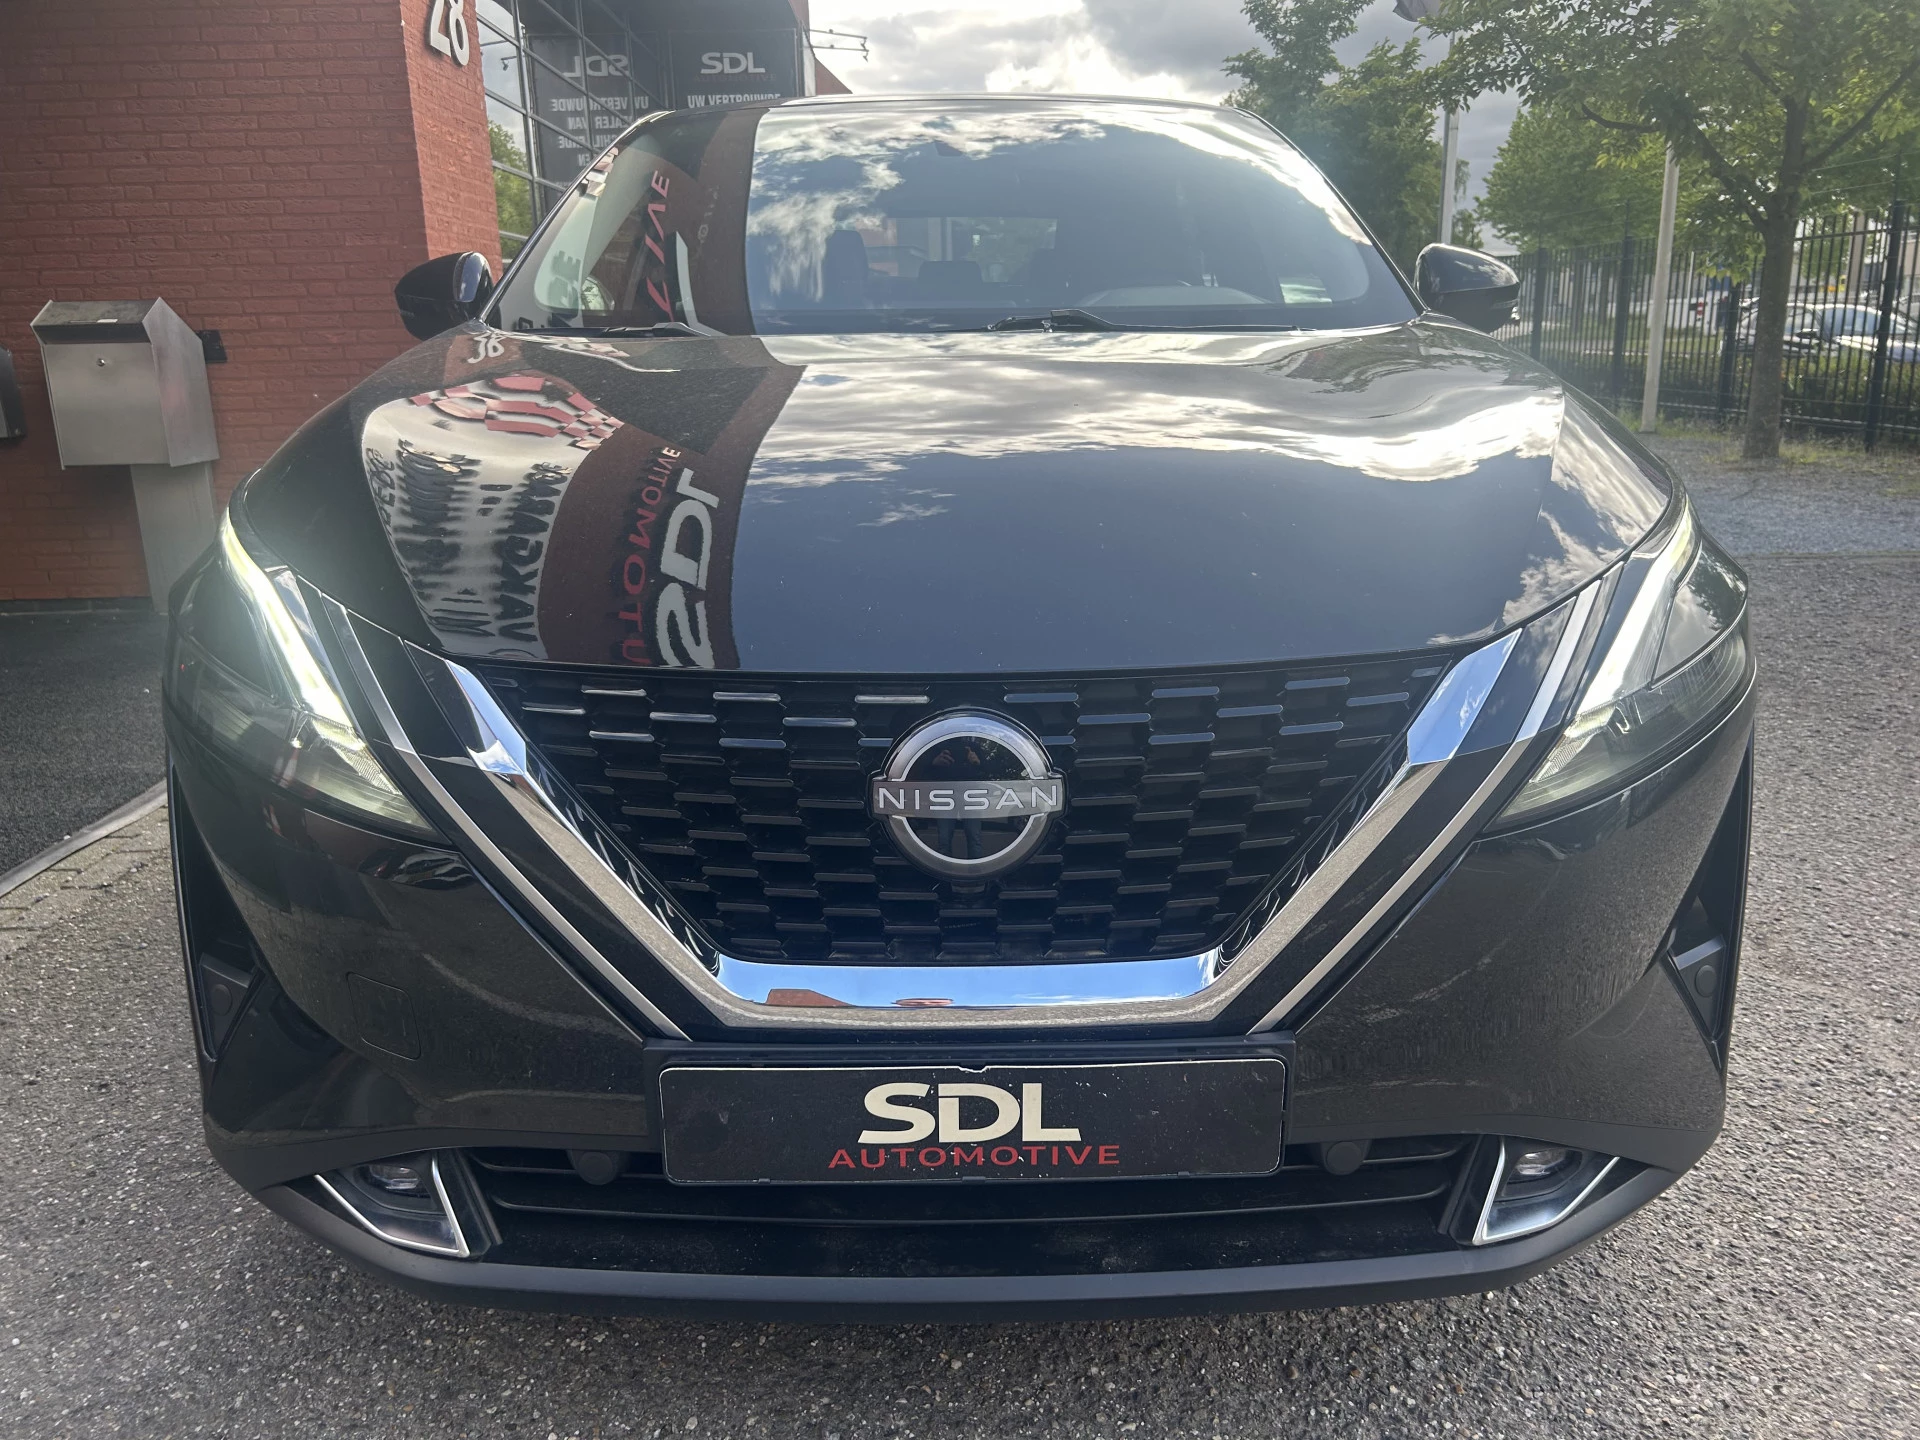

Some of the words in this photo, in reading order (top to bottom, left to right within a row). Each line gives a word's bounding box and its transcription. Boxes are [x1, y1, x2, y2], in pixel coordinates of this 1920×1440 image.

[700, 52, 766, 75] SDL
[687, 95, 706, 109] UW
[878, 785, 1057, 811] NISSAN
[857, 1082, 1082, 1144] SDL
[828, 1145, 1121, 1169] AUTOMOTIVE
